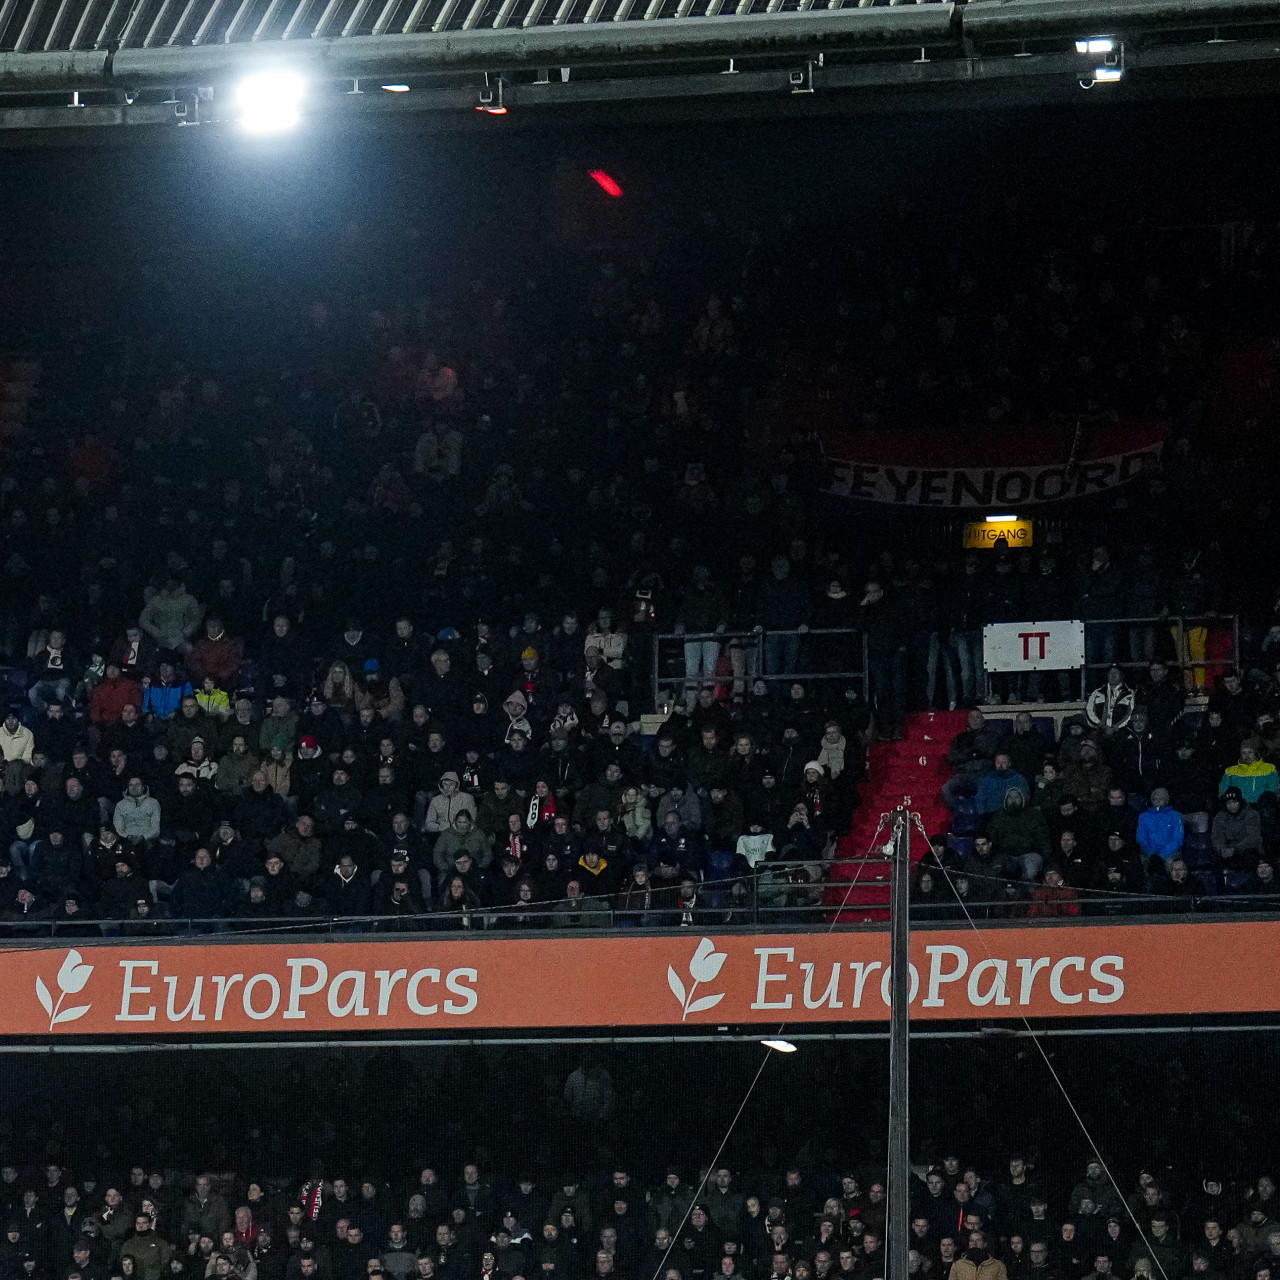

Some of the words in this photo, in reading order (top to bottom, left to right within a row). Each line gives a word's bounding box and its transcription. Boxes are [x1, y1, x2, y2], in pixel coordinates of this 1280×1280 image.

[1018, 631, 1050, 660] TT
[115, 957, 478, 1022] EuroParcs
[750, 945, 1125, 1011] EuroParcs
